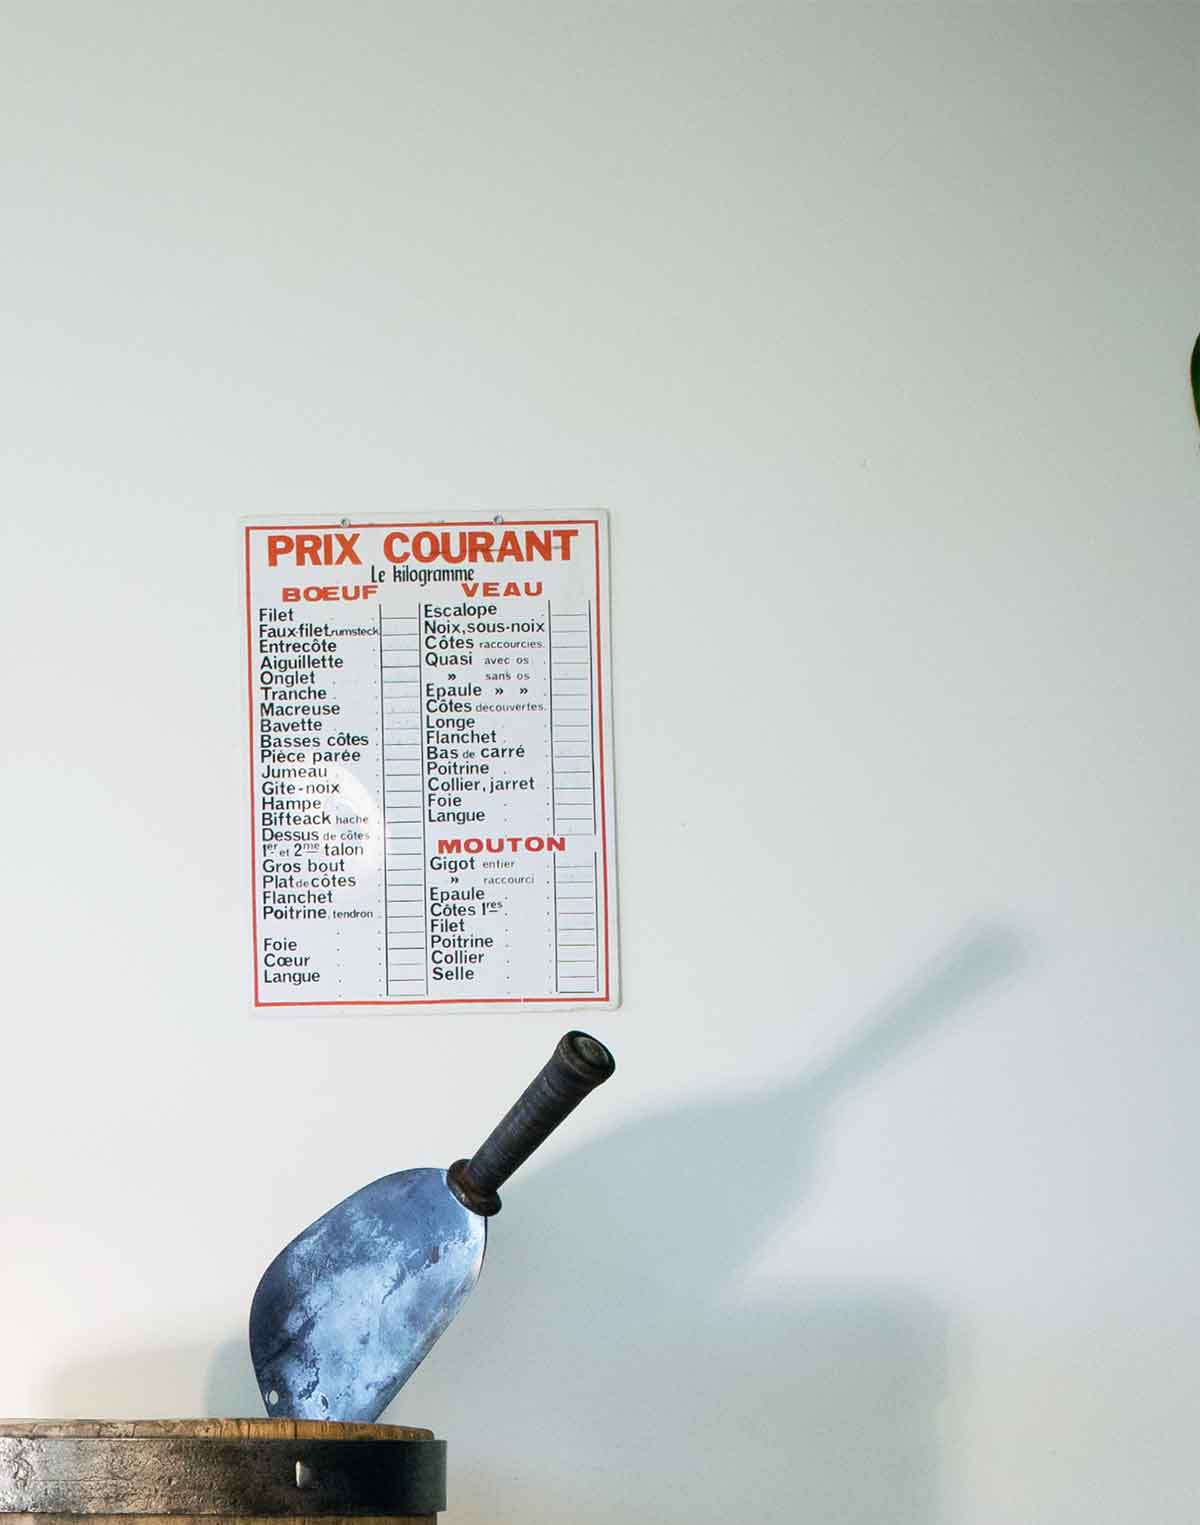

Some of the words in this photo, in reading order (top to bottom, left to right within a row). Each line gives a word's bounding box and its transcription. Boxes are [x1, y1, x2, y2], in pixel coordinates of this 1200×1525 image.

[267, 533, 362, 567] PRIX
[383, 529, 578, 564] COURANT
[371, 565, 386, 583] Le
[393, 565, 475, 586] kilogramme
[282, 585, 378, 603] BŒUF
[461, 582, 543, 598] VEAU
[259, 608, 294, 622] Filet
[424, 603, 497, 619] Escalope
[259, 639, 337, 653] Entrecôte
[425, 636, 474, 650] Côtes
[261, 655, 344, 672] Aiguillette
[425, 652, 473, 667] Quasi
[484, 657, 510, 665] avec
[260, 671, 315, 688] Onglet
[485, 672, 511, 680] sans
[261, 687, 327, 701] Tranche
[260, 703, 340, 716] Macreuse
[426, 699, 472, 713] Côtes
[260, 719, 322, 732] Bavette
[426, 715, 475, 731] Longe
[260, 735, 320, 748] Basses
[327, 733, 369, 746] côtes
[427, 731, 496, 744] Flanchet
[313, 750, 361, 764] parée
[427, 746, 458, 760] Bas
[463, 750, 475, 759] de
[481, 745, 525, 758] carré
[262, 765, 327, 778] Jumeau
[427, 762, 489, 775] Poitrine
[489, 777, 535, 793] jarret
[262, 797, 322, 812] Hampe
[428, 794, 461, 807] Foie
[262, 812, 331, 826] Bifteack
[428, 810, 485, 824] Langue
[262, 828, 319, 841] Dessus
[323, 833, 336, 841] de
[341, 831, 370, 840] côtes
[325, 843, 364, 856] talon
[438, 836, 566, 854] MOUTON
[263, 859, 301, 873] Gros
[308, 859, 344, 872] bout
[430, 856, 475, 873] Gigot
[482, 860, 515, 868] entier
[263, 875, 295, 888] Plat
[296, 879, 309, 887] de
[311, 874, 356, 887] côtes
[484, 874, 535, 884] raccourci
[263, 890, 333, 904] Flanchet
[430, 887, 485, 903] Epaule
[333, 910, 373, 919] tendron
[431, 903, 476, 916] Côtes
[431, 919, 465, 933] Filet
[264, 938, 297, 952] Foie
[431, 935, 493, 948] Poitrine
[264, 954, 310, 968] Cœur
[431, 950, 485, 965] Collier
[264, 970, 320, 985] Langue
[433, 967, 474, 980] Selle
